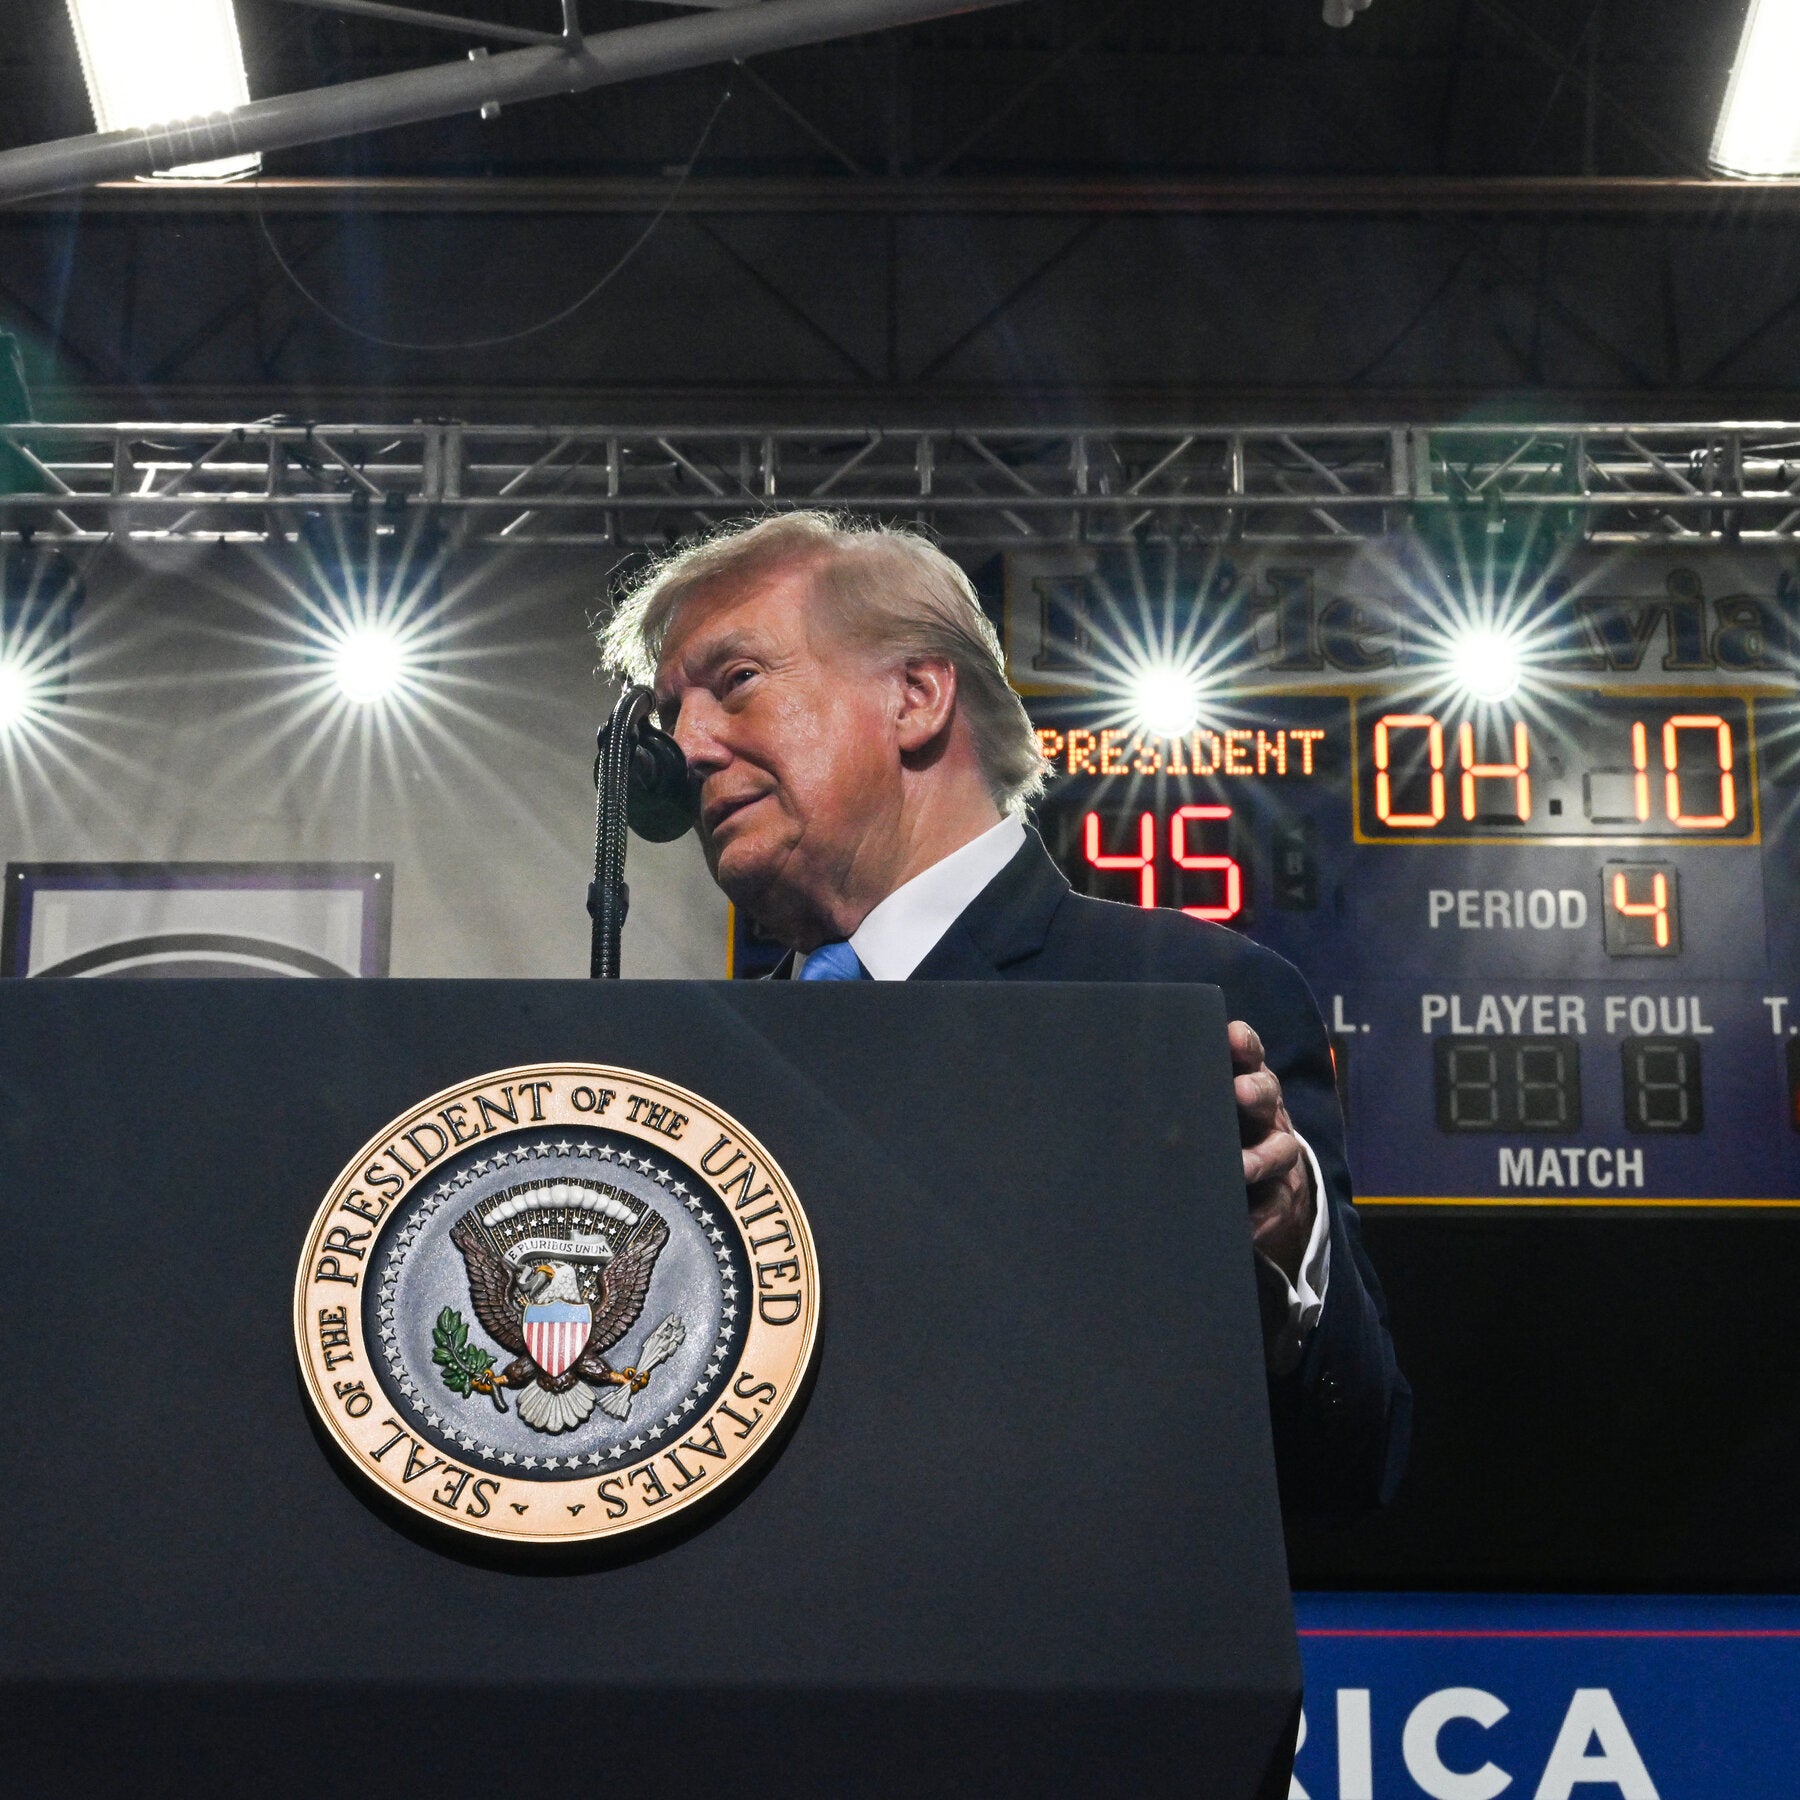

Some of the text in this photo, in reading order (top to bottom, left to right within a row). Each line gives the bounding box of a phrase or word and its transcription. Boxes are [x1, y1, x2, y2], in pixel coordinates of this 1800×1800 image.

[1036, 729, 1326, 775] PRESIDENT
[1084, 804, 1241, 920] 45
[1428, 890, 1588, 930] PERIOD
[1613, 872, 1669, 948] 4
[1421, 994, 1714, 1034] PLAYER FOUL
[1499, 1148, 1644, 1188] MATCH
[508, 1240, 609, 1261] E PLURIBUS UNUM
[316, 1081, 803, 1519] SEAL OF THE PRESIDENT OF THE UNITED STATES
[1287, 1687, 1662, 1800] ICA
